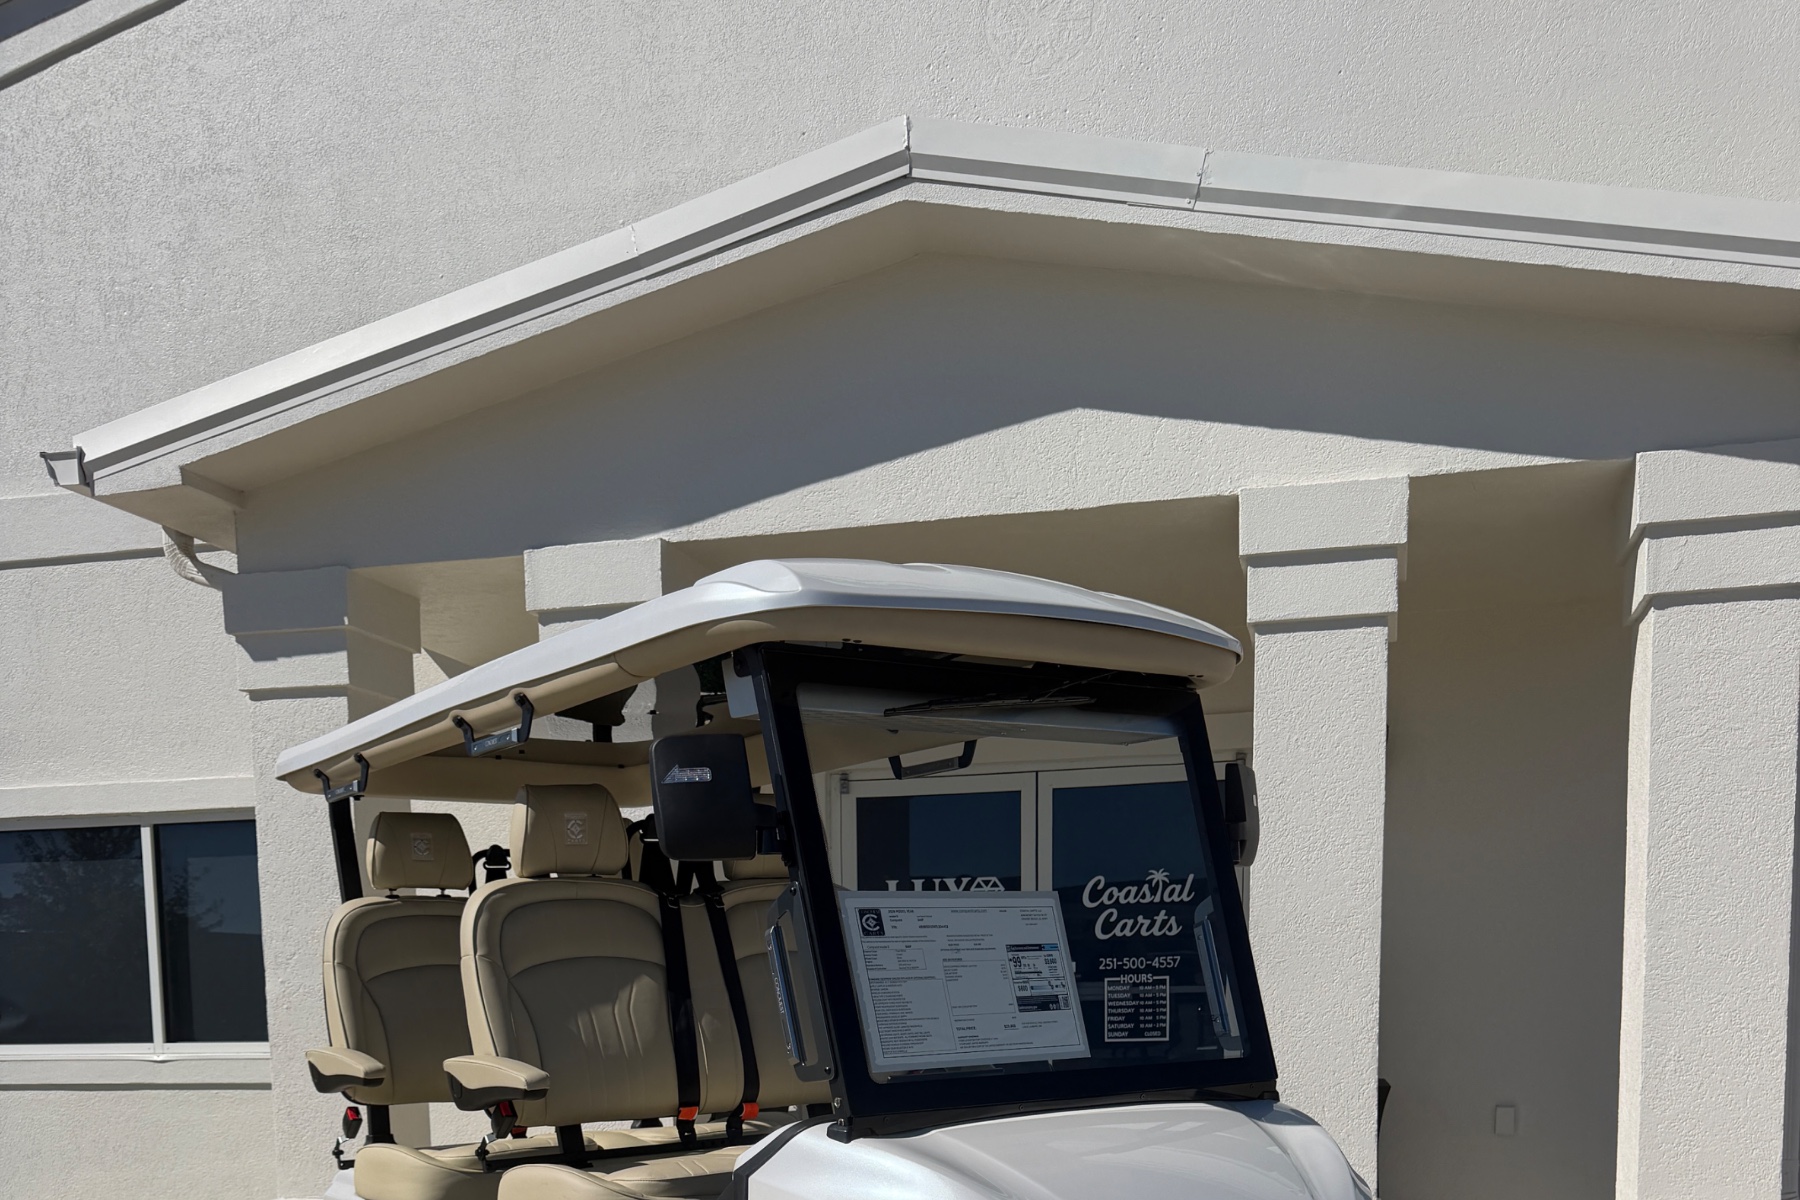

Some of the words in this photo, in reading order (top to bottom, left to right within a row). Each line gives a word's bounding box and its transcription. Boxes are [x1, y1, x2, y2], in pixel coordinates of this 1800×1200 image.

[1082, 868, 1195, 908] Coastal
[1094, 908, 1182, 940] Carts
[1013, 956, 1022, 967] 99
[1099, 956, 1180, 970] 251-500-4557
[1120, 974, 1152, 983] HOURS
